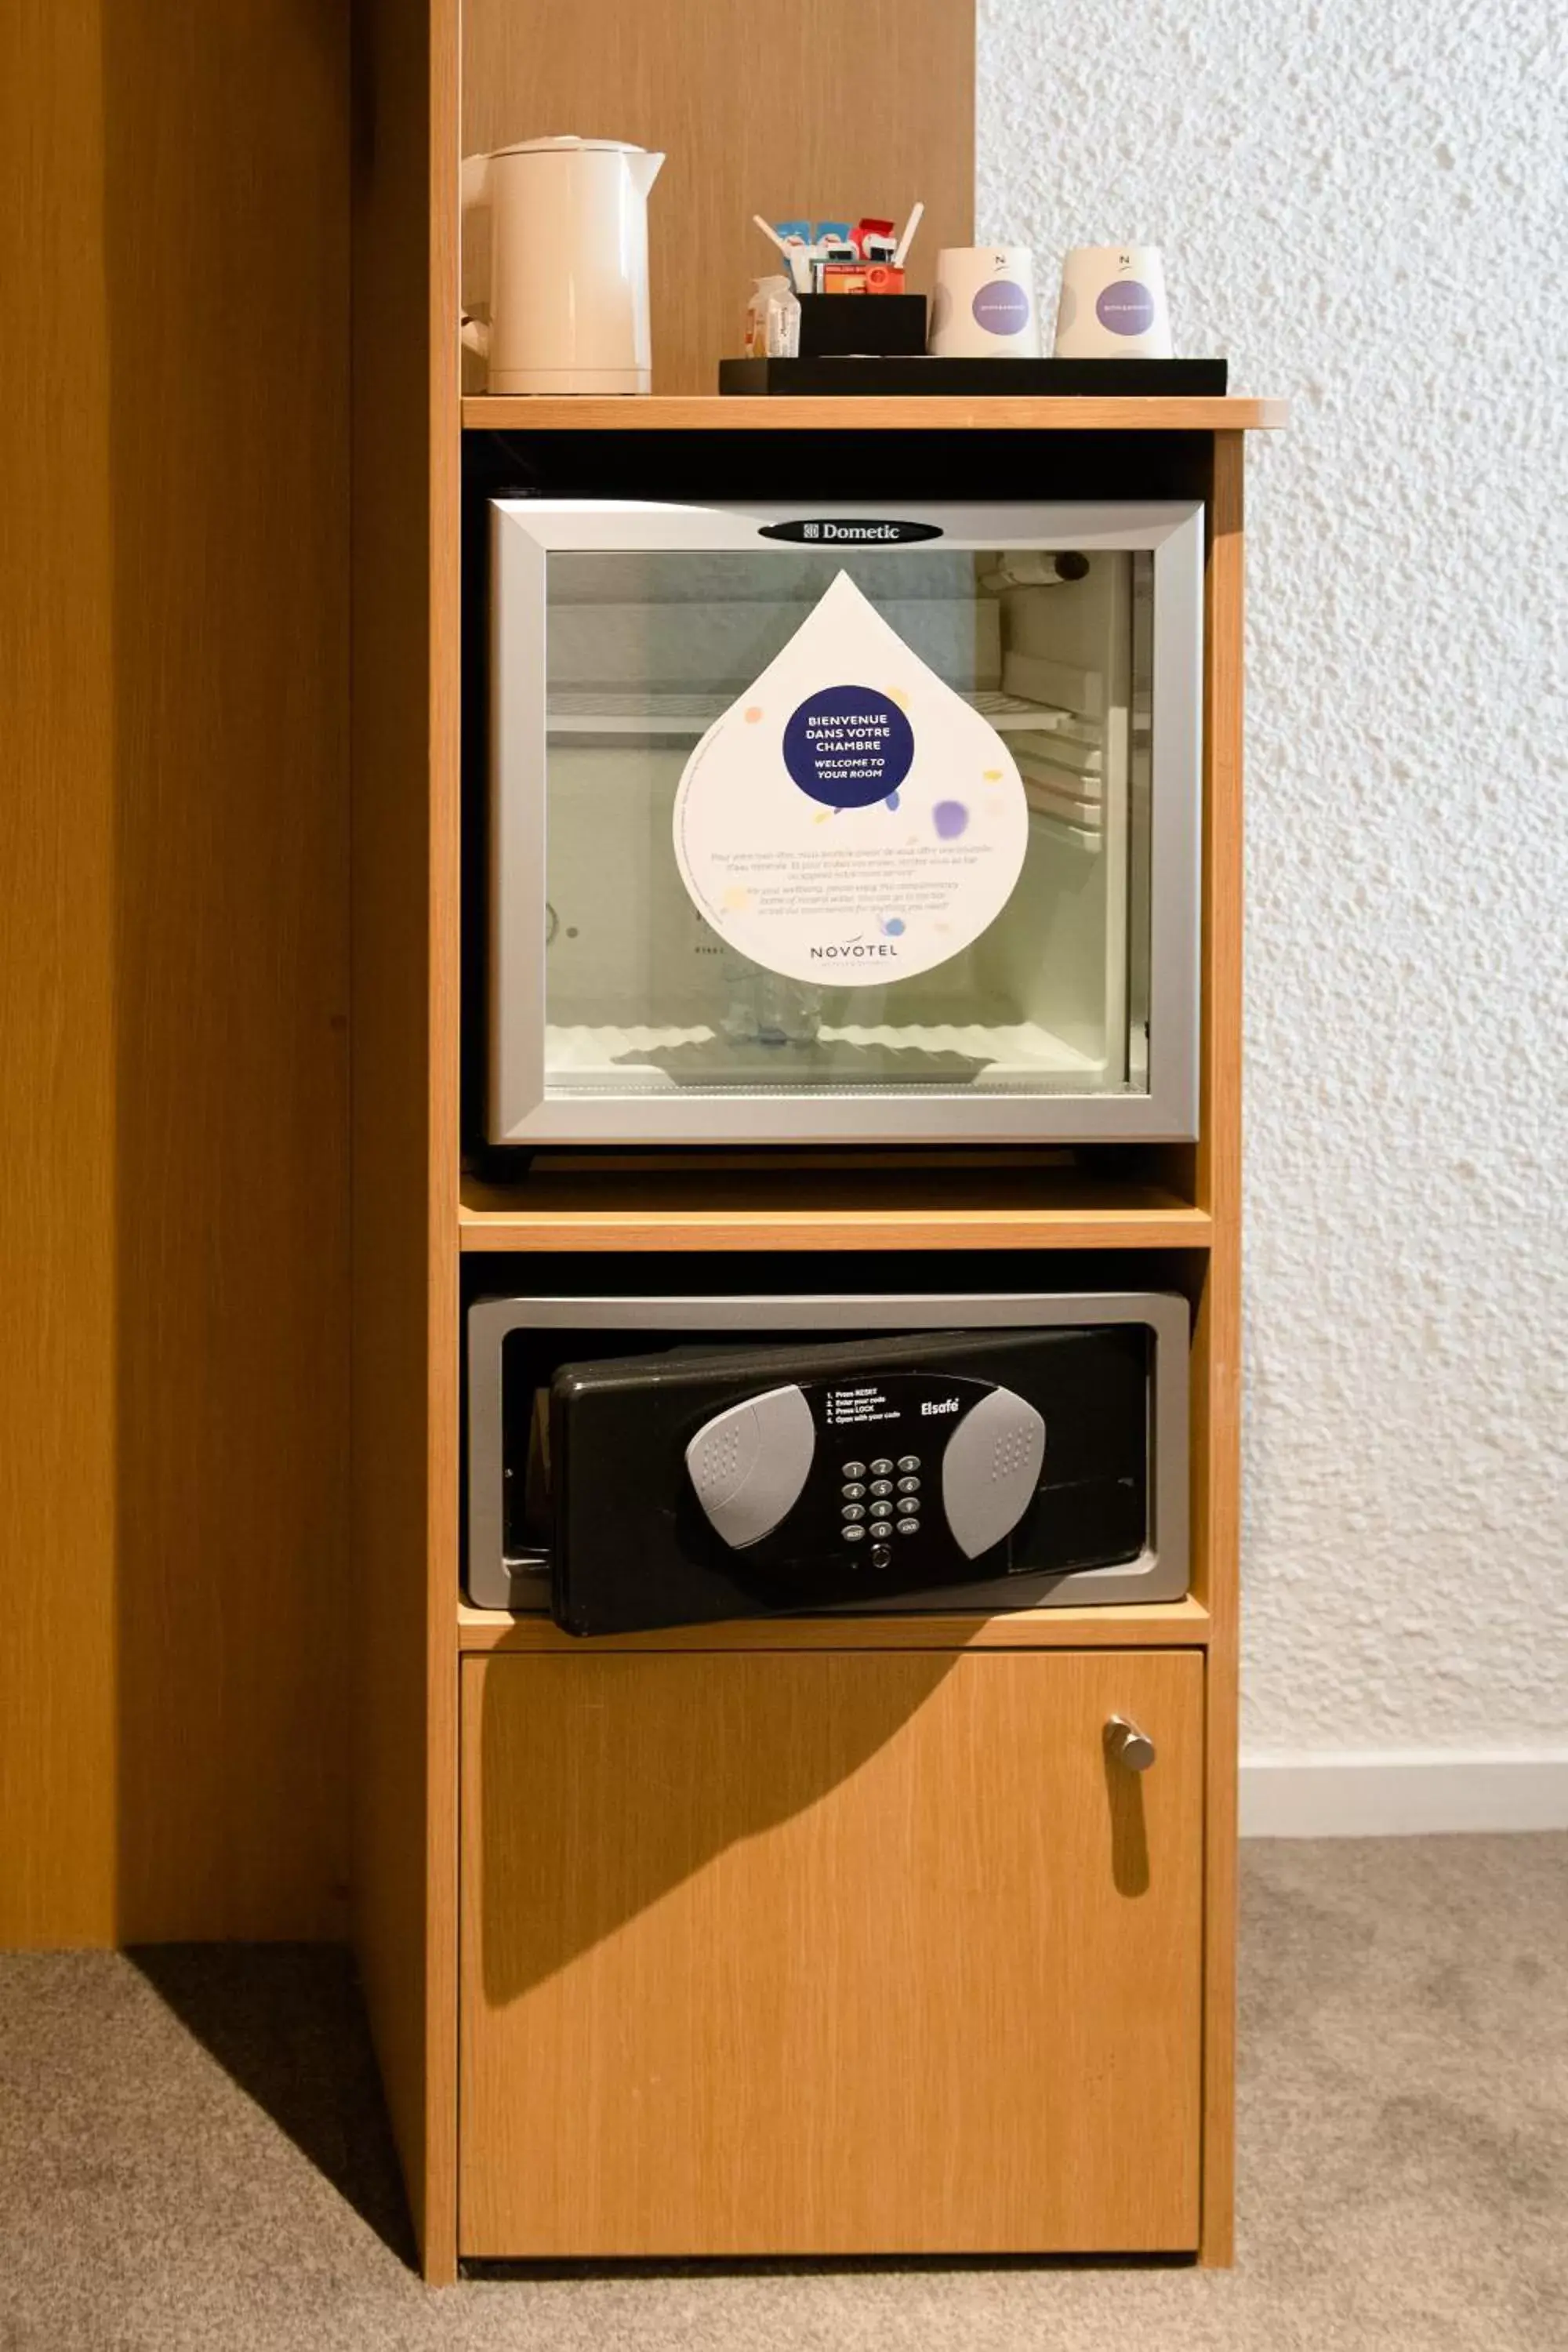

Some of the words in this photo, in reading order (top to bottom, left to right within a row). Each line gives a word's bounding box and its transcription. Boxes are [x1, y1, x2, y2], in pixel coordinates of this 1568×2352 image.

[824, 524, 900, 539] Dometic
[808, 714, 888, 726] BIENVENUE
[806, 728, 844, 739] DANS
[847, 728, 891, 738] VOTRE
[816, 741, 881, 752] CHAMBRE
[815, 758, 868, 768] WELCOME
[850, 769, 883, 779] ROOM
[810, 945, 898, 959] NOVOTEL
[879, 1465, 886, 1473] 2
[907, 1461, 913, 1470] 3
[906, 1482, 913, 1490] 6
[879, 1506, 885, 1515] 8
[879, 1526, 885, 1536] 0
